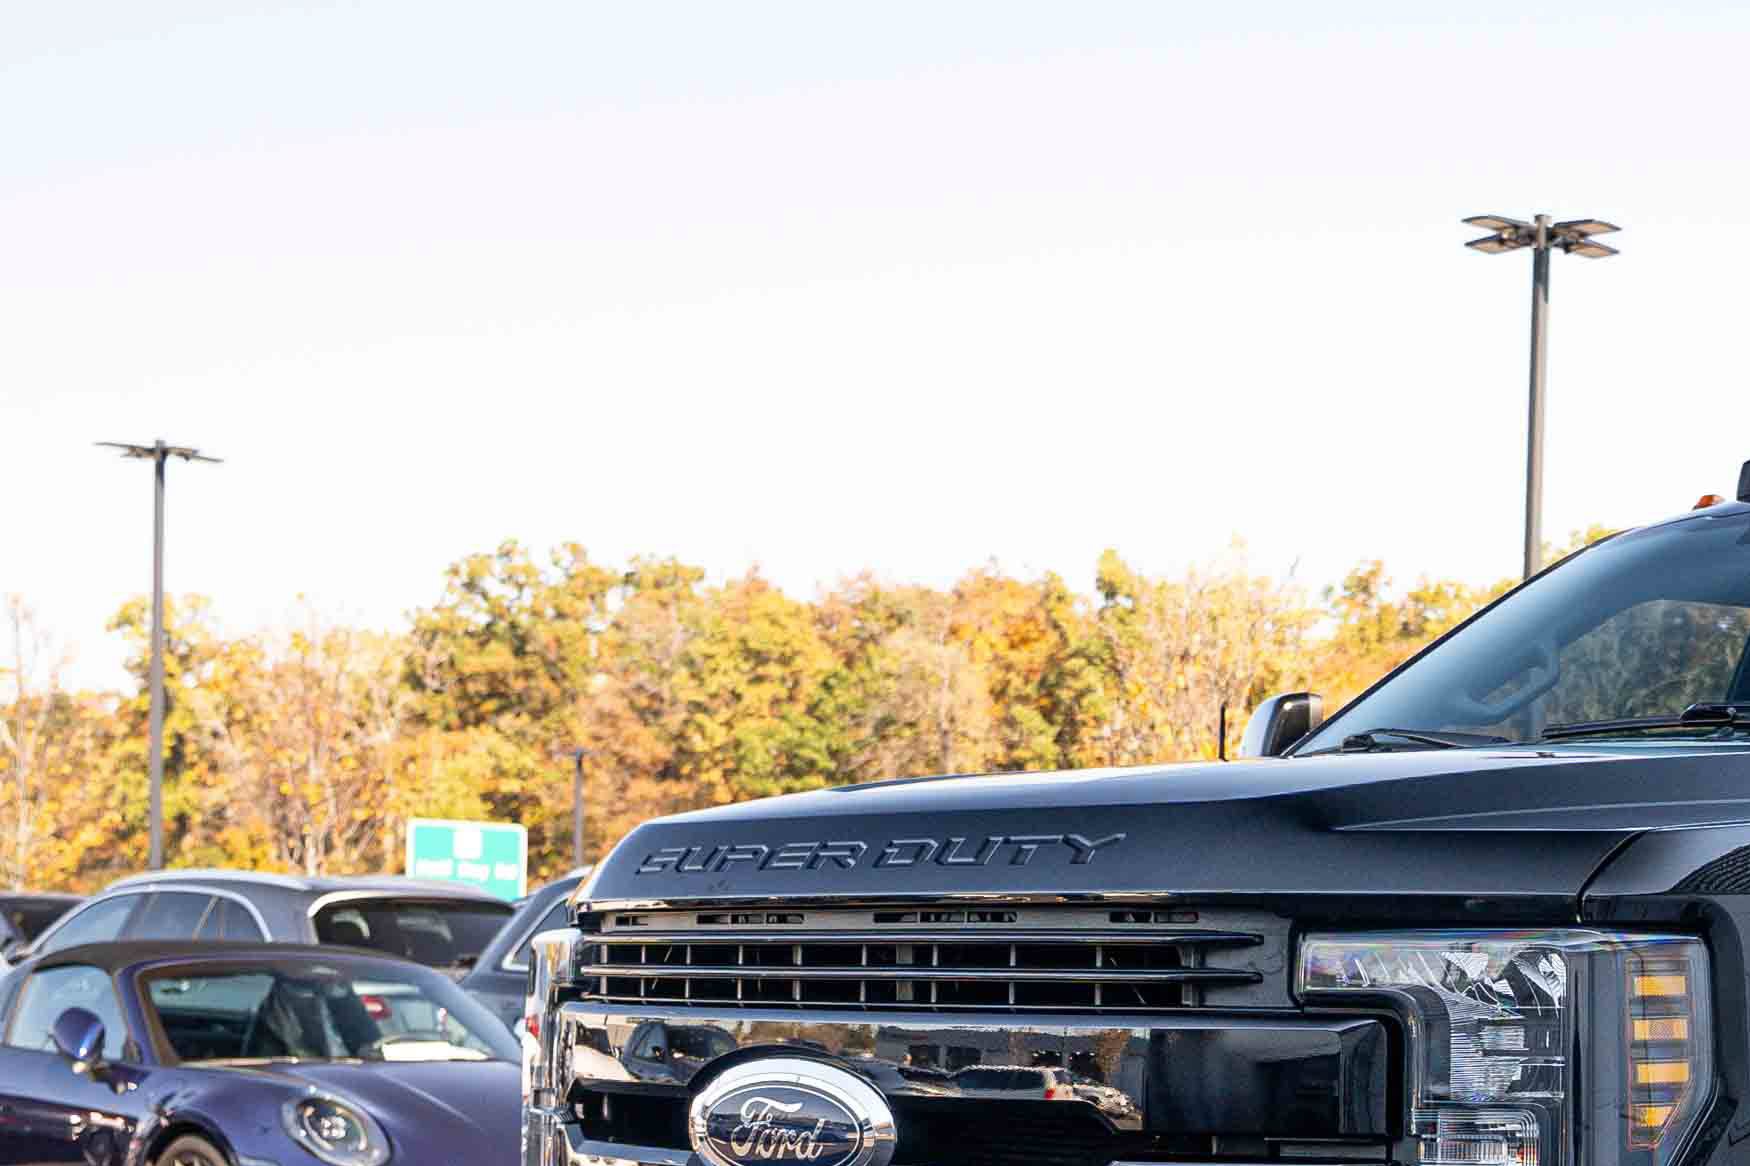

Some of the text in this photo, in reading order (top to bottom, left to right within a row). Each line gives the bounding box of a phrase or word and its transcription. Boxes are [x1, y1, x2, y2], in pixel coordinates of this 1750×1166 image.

[634, 832, 1128, 875] SUPER DUTY
[731, 1096, 826, 1160] Ford
